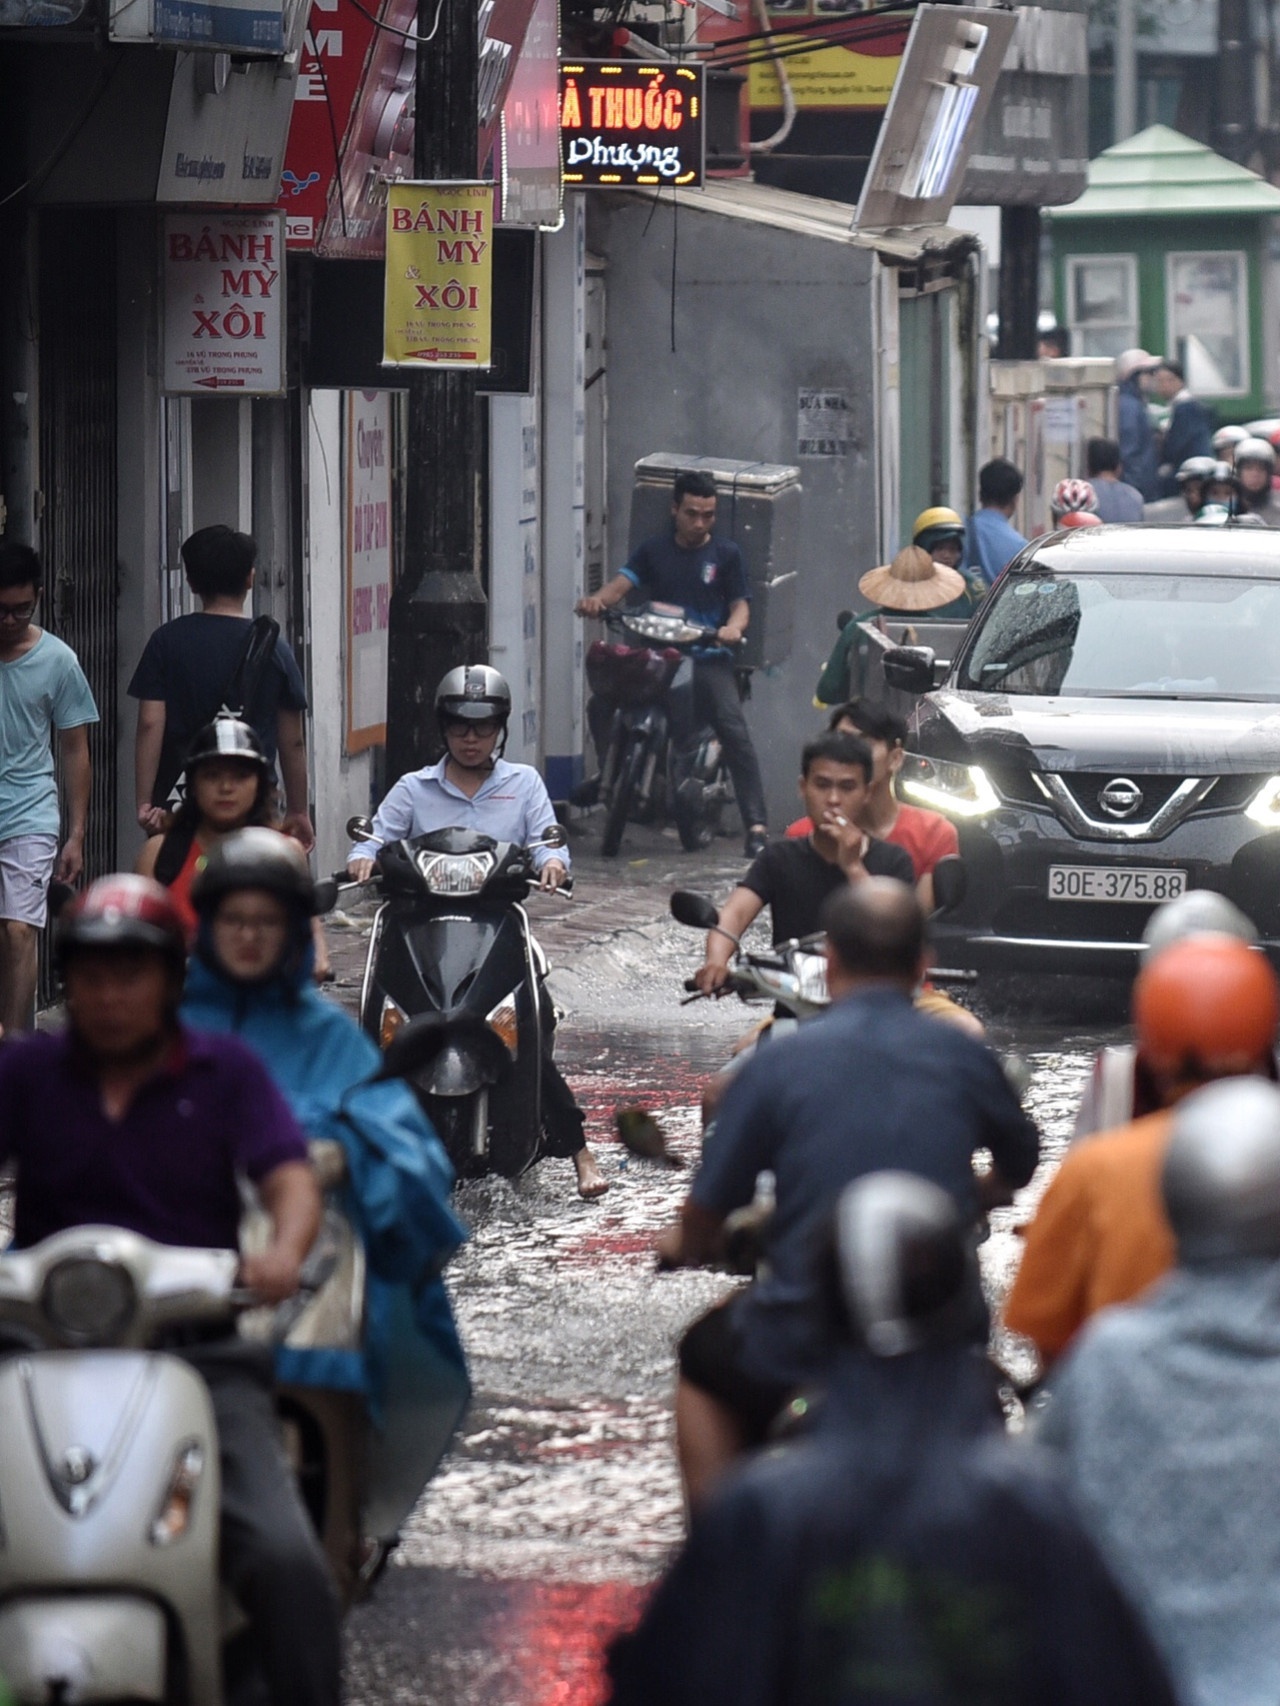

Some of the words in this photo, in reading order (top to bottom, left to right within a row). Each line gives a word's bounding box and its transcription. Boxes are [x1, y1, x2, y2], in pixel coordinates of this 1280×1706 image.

[588, 74, 682, 130] THUỐC
[567, 136, 681, 176] Phượng
[392, 201, 485, 234] BÁNH
[169, 225, 275, 262] BÁNH
[437, 233, 488, 265] MỲ
[220, 261, 279, 298] MỲ
[405, 265, 420, 279] &
[414, 279, 479, 311] XÔI
[192, 302, 266, 340] XÔI
[1052, 871, 1182, 900] 30E-375.88
